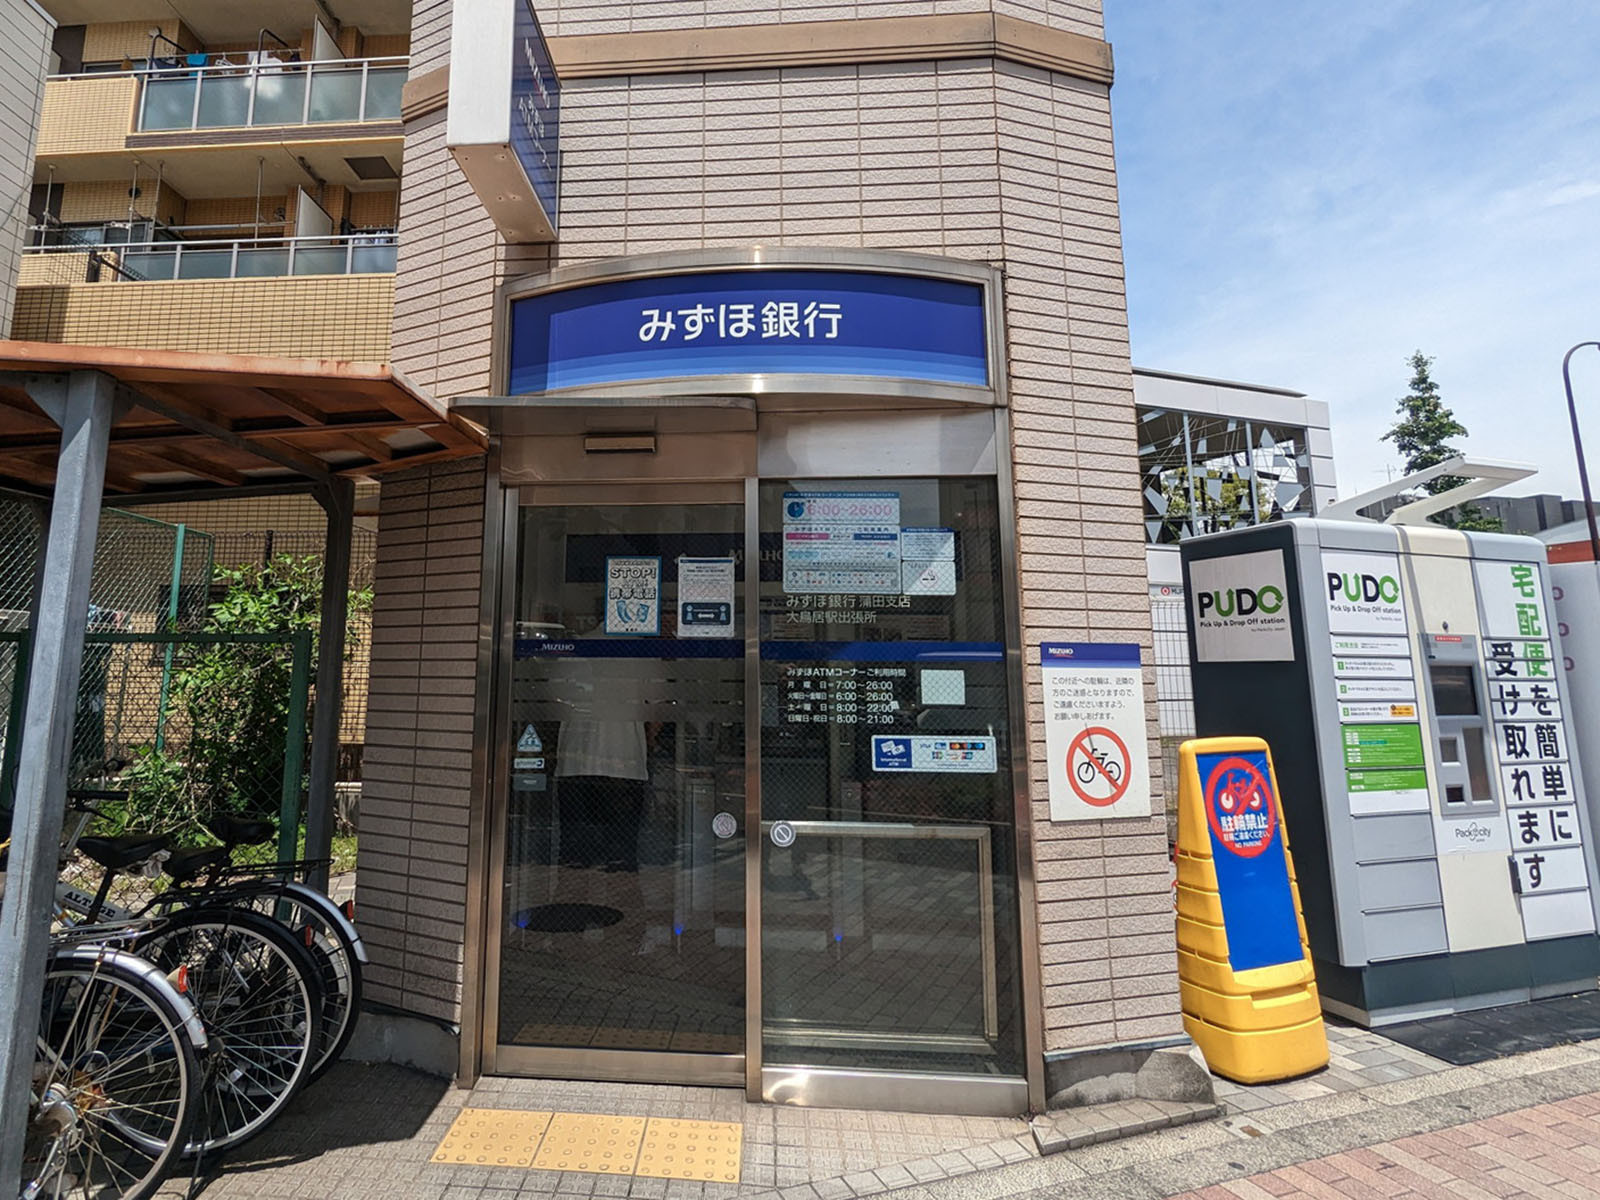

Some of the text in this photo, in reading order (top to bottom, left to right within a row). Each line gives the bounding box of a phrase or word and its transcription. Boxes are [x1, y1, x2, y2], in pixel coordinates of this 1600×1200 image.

[639, 301, 843, 342] みずほ銀行
[610, 567, 657, 579] STOP!
[1327, 572, 1400, 604] PUDO
[785, 594, 912, 609] みずほ銀行 蒲田支店
[1197, 585, 1284, 619] PUDO
[1342, 605, 1351, 613] Up
[785, 610, 877, 624] 大鳥居駅出張所
[1229, 619, 1245, 627] Drop
[1260, 617, 1285, 625] station
[541, 643, 575, 652] MIZUHO
[1048, 647, 1074, 655] MIZUHO
[786, 668, 906, 677] みずほATMコーナーご利用時間
[1510, 564, 1572, 842] 宅配便を簡単に
[1490, 641, 1545, 889] 受け取れます
[1220, 812, 1269, 832] 駐輪禁止
[64, 891, 116, 918] ALTGE
